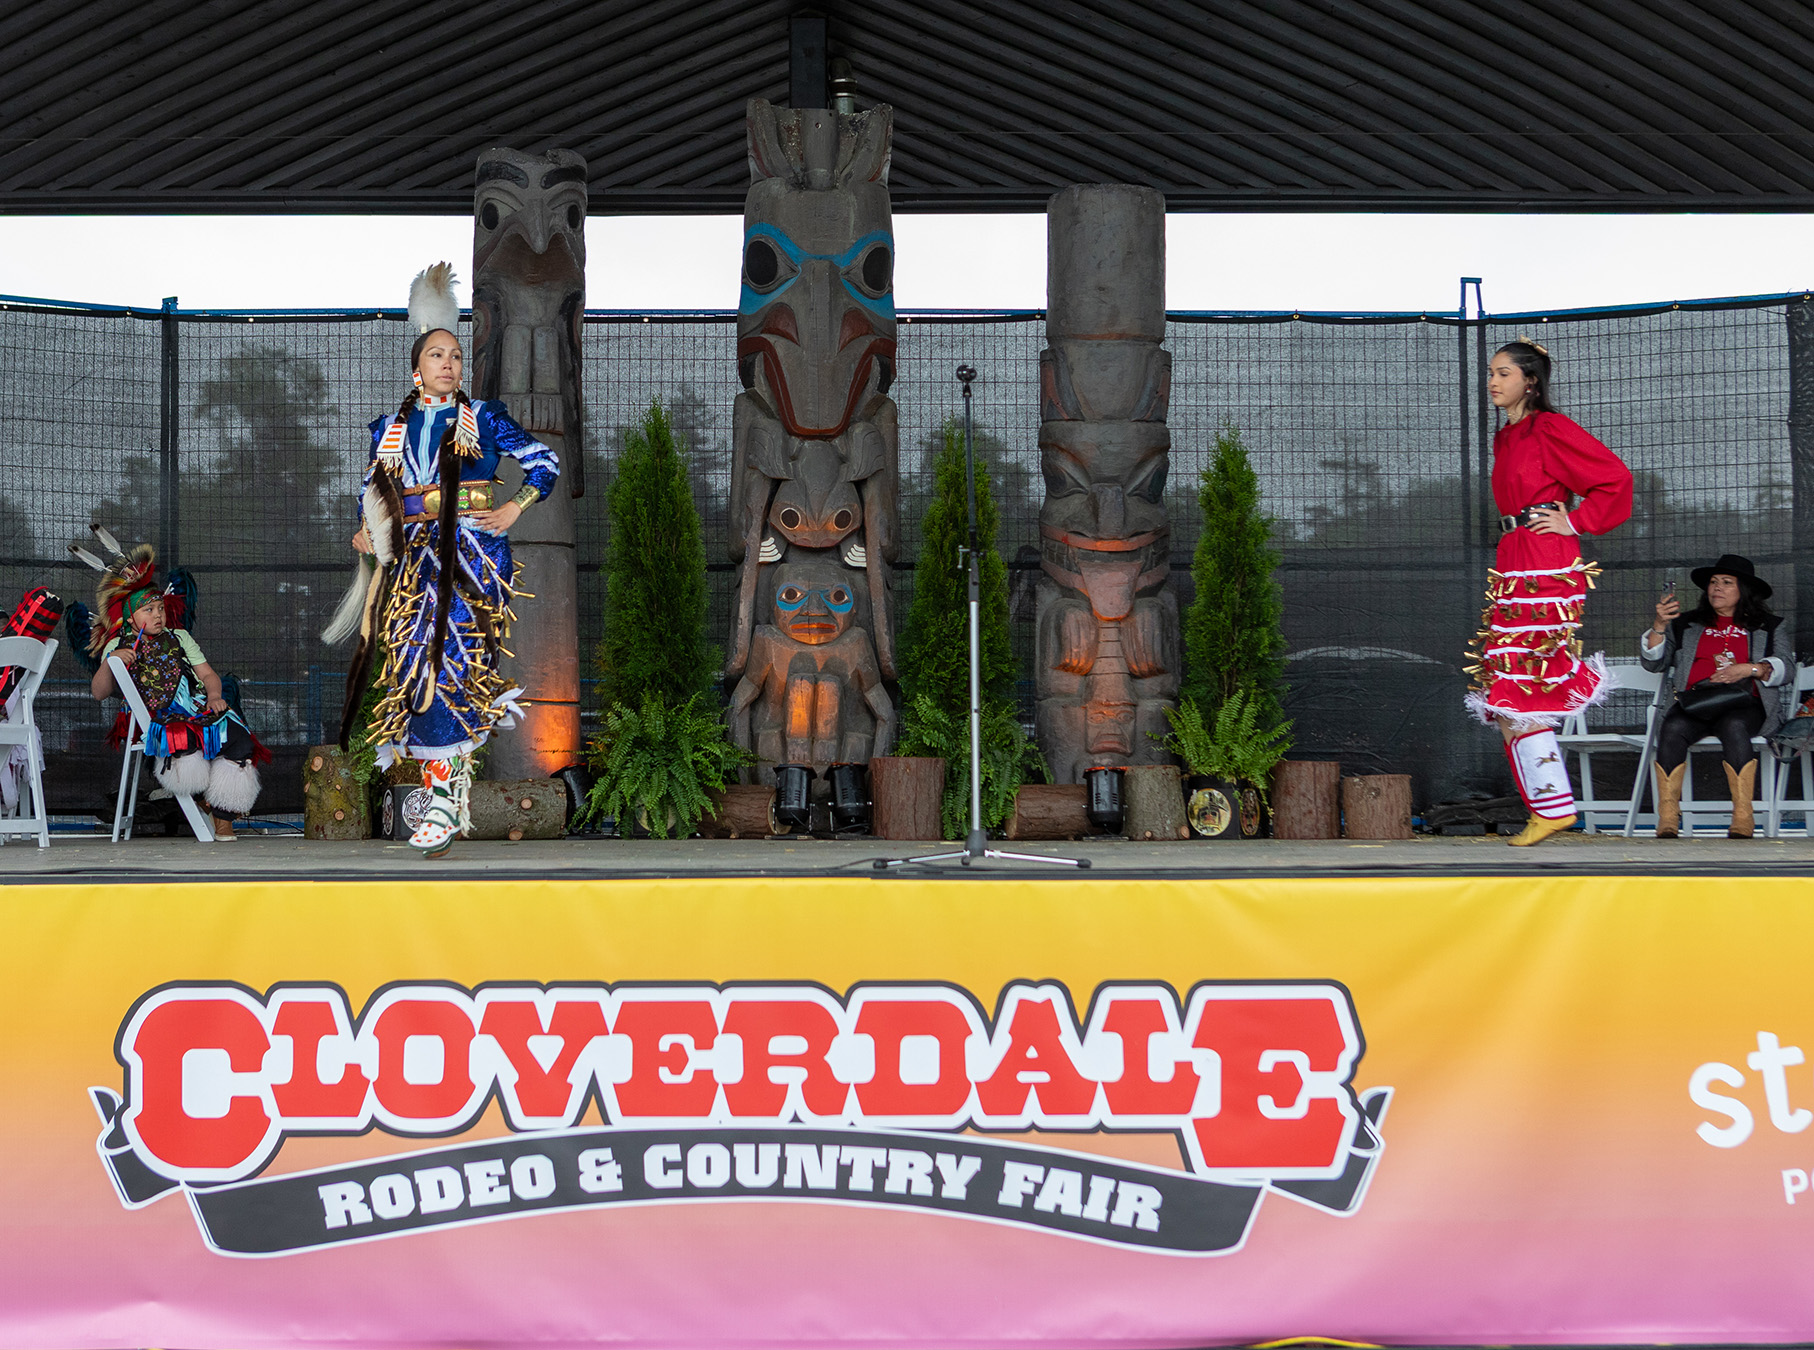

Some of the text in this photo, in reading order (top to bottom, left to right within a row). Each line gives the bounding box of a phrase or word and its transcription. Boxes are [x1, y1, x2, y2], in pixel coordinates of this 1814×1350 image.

[133, 999, 1346, 1168] CLOVERDALE
[318, 1143, 1163, 1232] RODEO & COUNTRY FAIR
